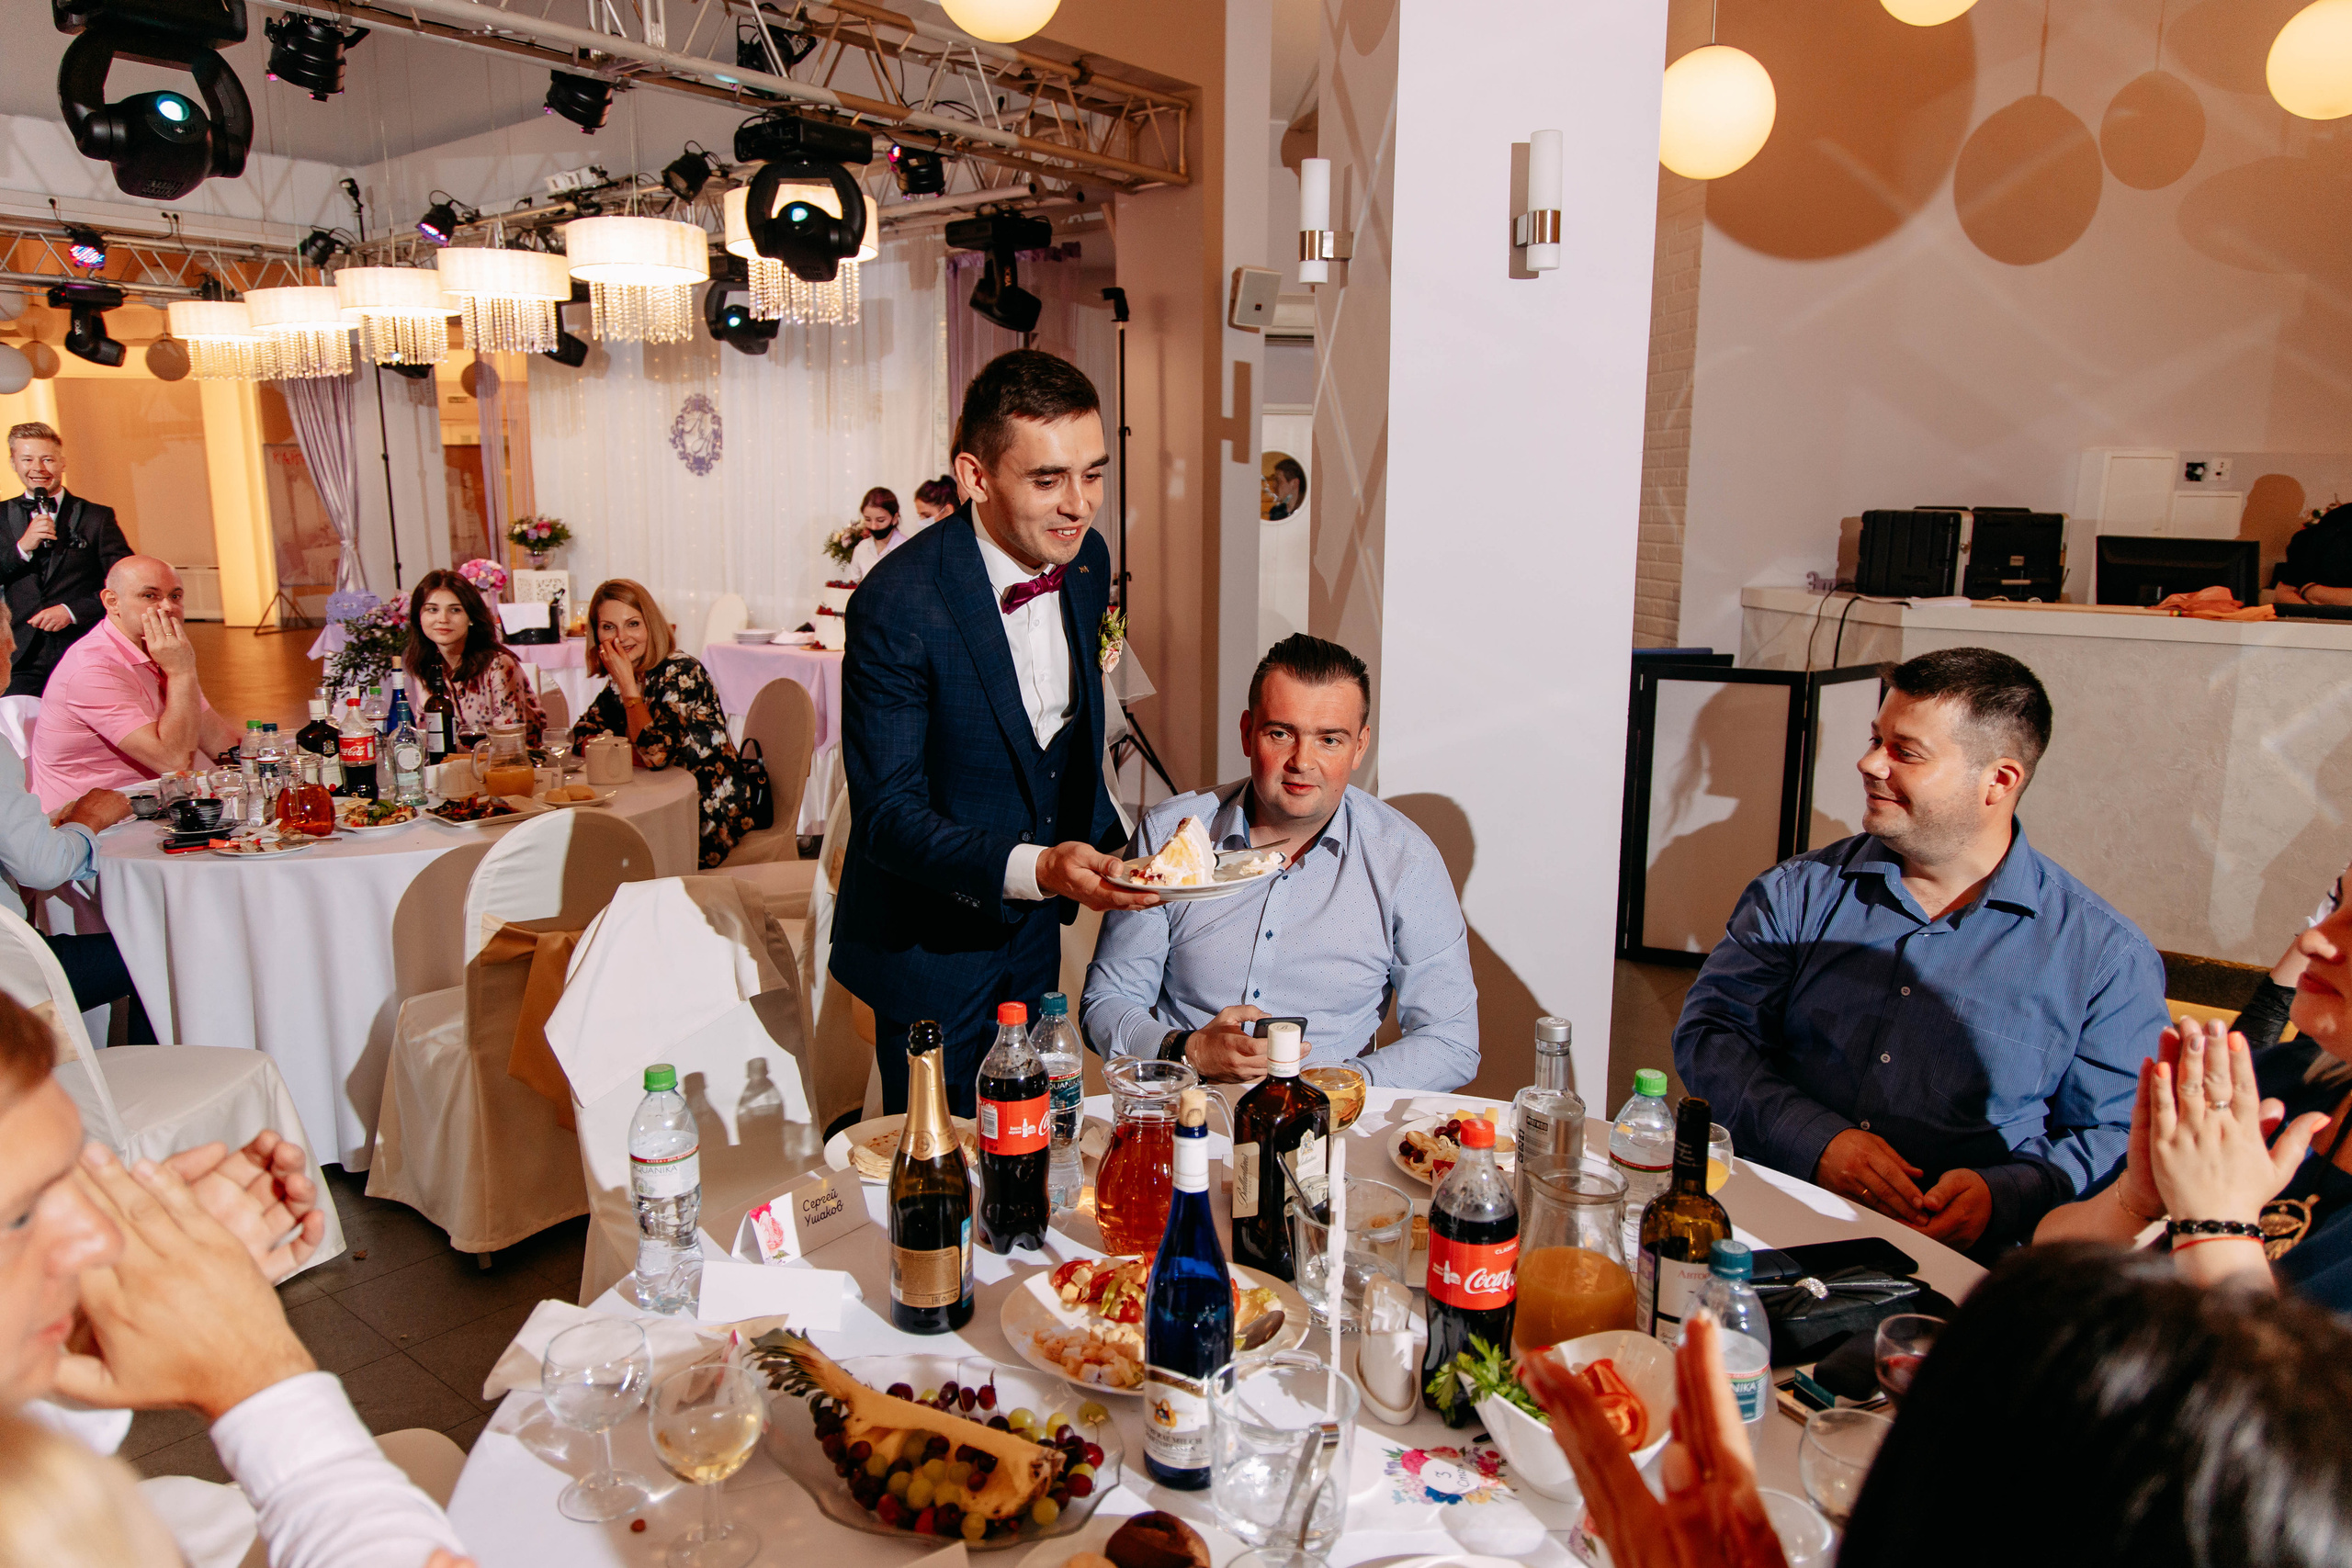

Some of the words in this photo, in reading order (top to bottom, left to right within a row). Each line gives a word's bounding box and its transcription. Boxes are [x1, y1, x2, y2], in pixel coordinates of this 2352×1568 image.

[632, 1163, 677, 1174] AQUANIKA
[802, 1188, 839, 1212] Сергей
[804, 1199, 844, 1227] Ушаков
[1730, 1382, 1757, 1393] NIKA
[1434, 1471, 1452, 1479] 3
